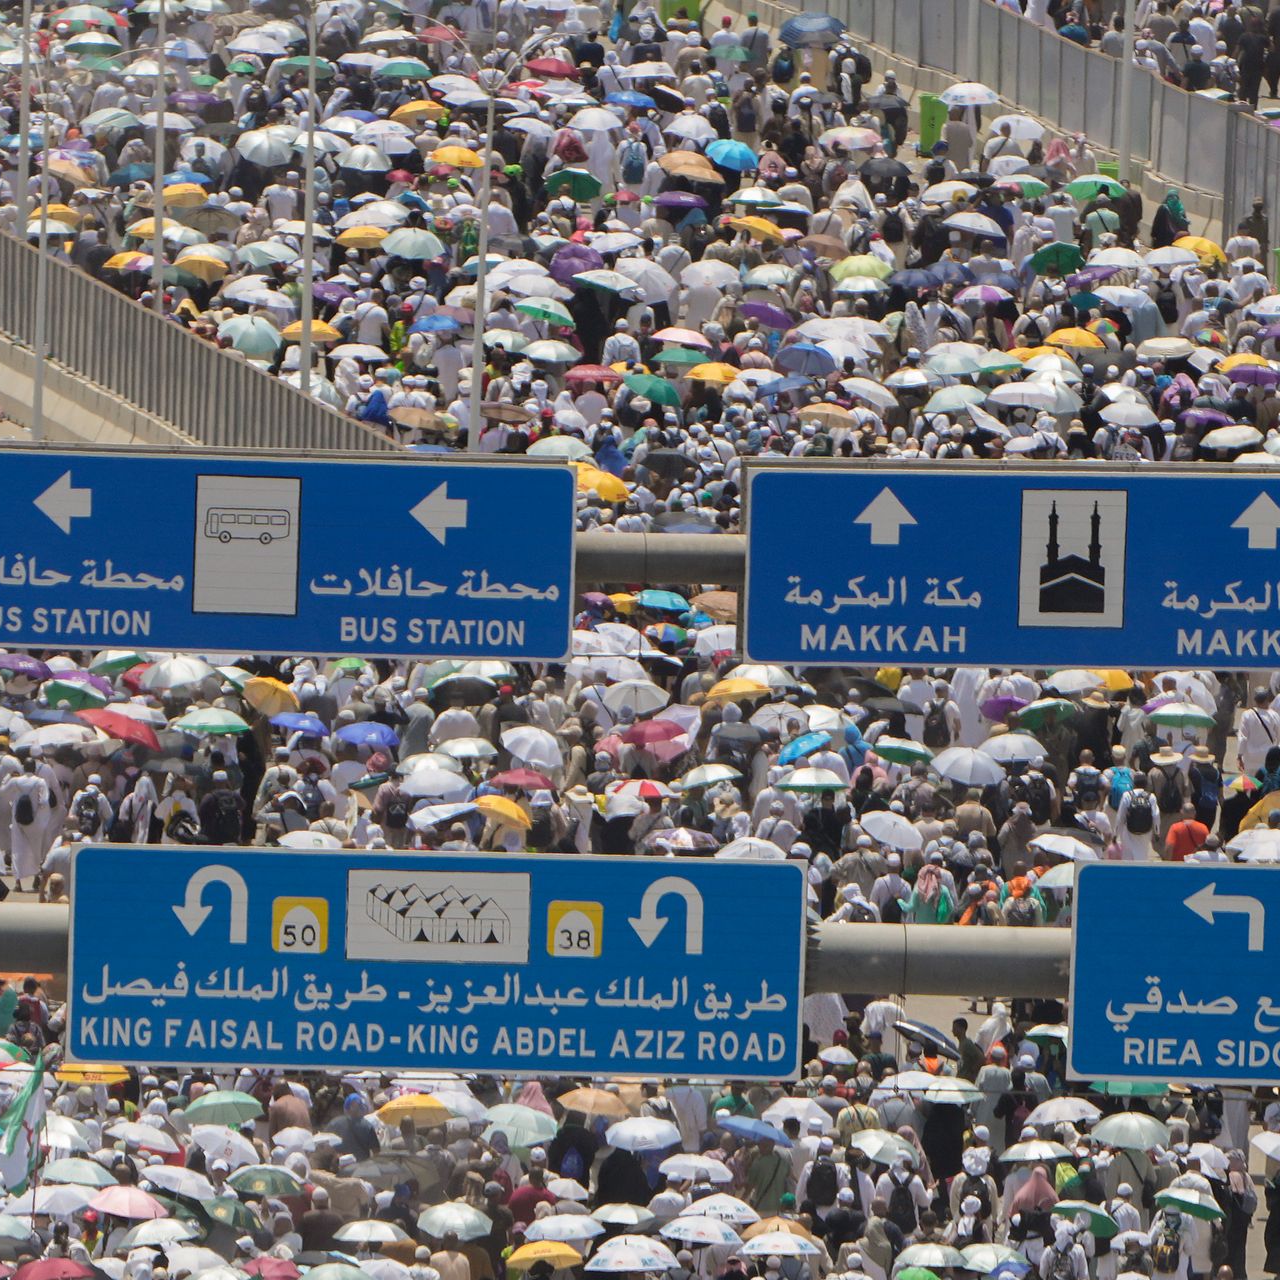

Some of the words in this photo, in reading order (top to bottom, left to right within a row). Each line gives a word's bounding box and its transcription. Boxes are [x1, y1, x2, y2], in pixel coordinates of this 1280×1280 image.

[81, 559, 184, 591] محطة
[310, 564, 447, 597] حافلات
[457, 570, 559, 601] محطة
[785, 575, 906, 614] المكرمة
[924, 577, 981, 608] مكة
[32, 607, 150, 635] STATION
[341, 616, 396, 643] BUS
[407, 618, 524, 645] STATION
[801, 624, 966, 652] MAKKAH
[283, 924, 316, 948] 50
[560, 929, 591, 951] 38
[82, 961, 189, 1006] فيصل
[195, 967, 288, 1001] الملك
[294, 971, 387, 1011] طريق
[595, 976, 688, 1010] الملك
[694, 980, 787, 1020] طريق
[1106, 976, 1238, 1031] صدقي
[81, 1017, 151, 1046] KING
[165, 1019, 283, 1049] FAISAL
[493, 1027, 596, 1057] ABDEL
[610, 1029, 685, 1059] AZIZ
[698, 1031, 786, 1061] ROAD
[1124, 1038, 1202, 1065] RIEA
